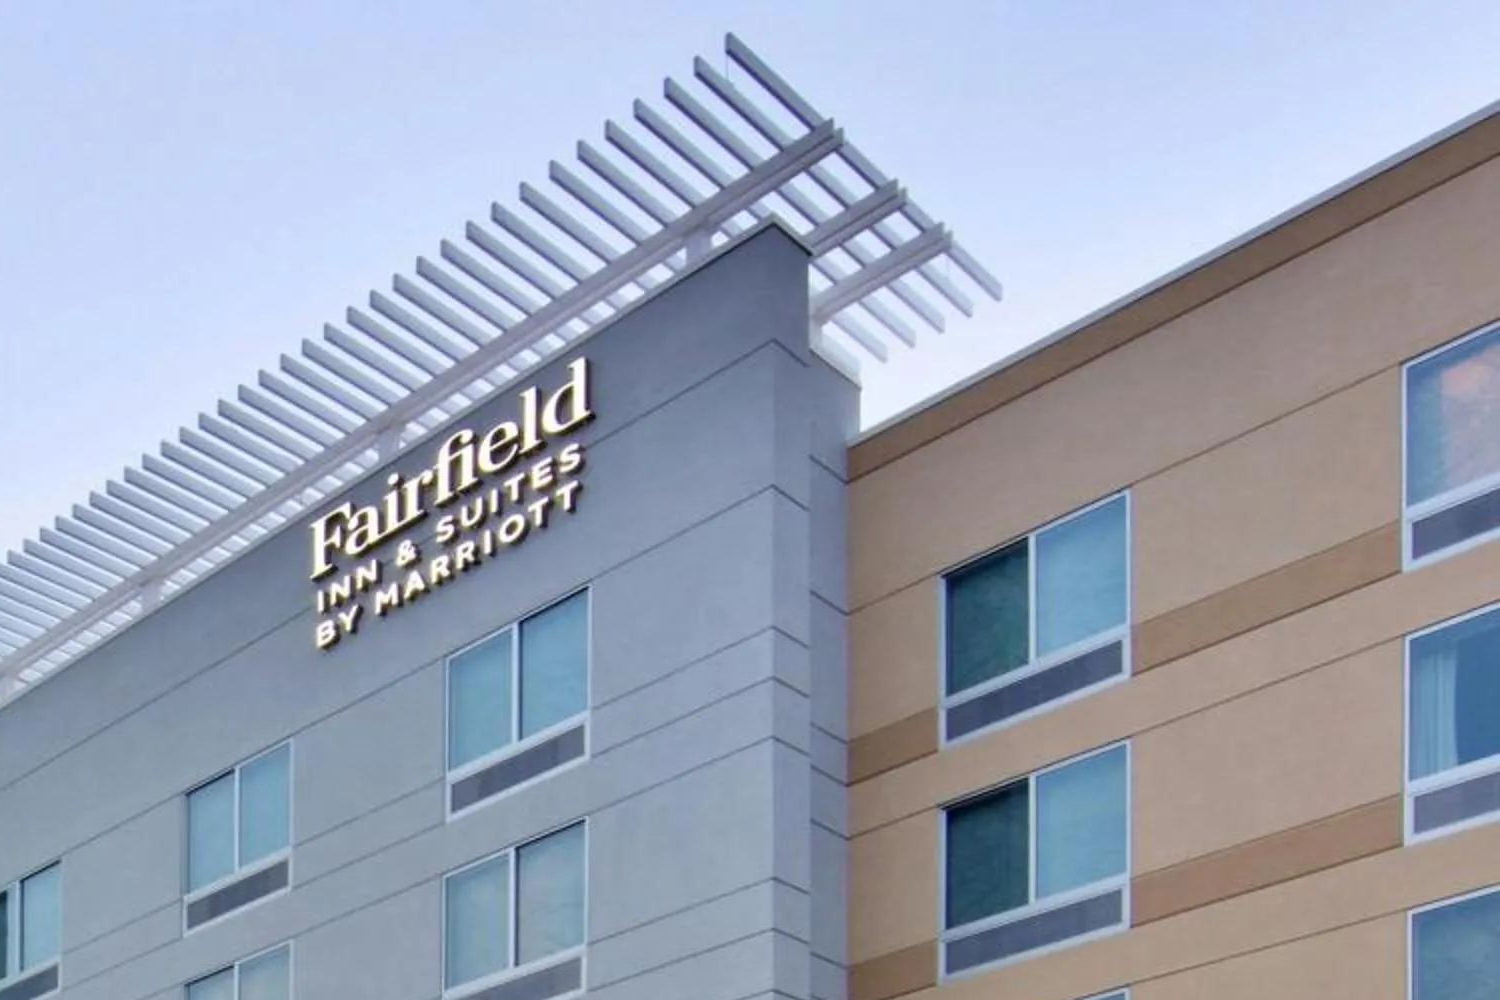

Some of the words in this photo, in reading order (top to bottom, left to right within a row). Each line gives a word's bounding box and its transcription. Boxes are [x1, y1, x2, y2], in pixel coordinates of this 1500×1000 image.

[309, 356, 592, 579] Fairfield
[317, 558, 378, 613] INN
[396, 540, 416, 567] &
[436, 442, 581, 543] SUITES
[316, 605, 359, 649] BY
[375, 480, 580, 615] MARRIOTT
